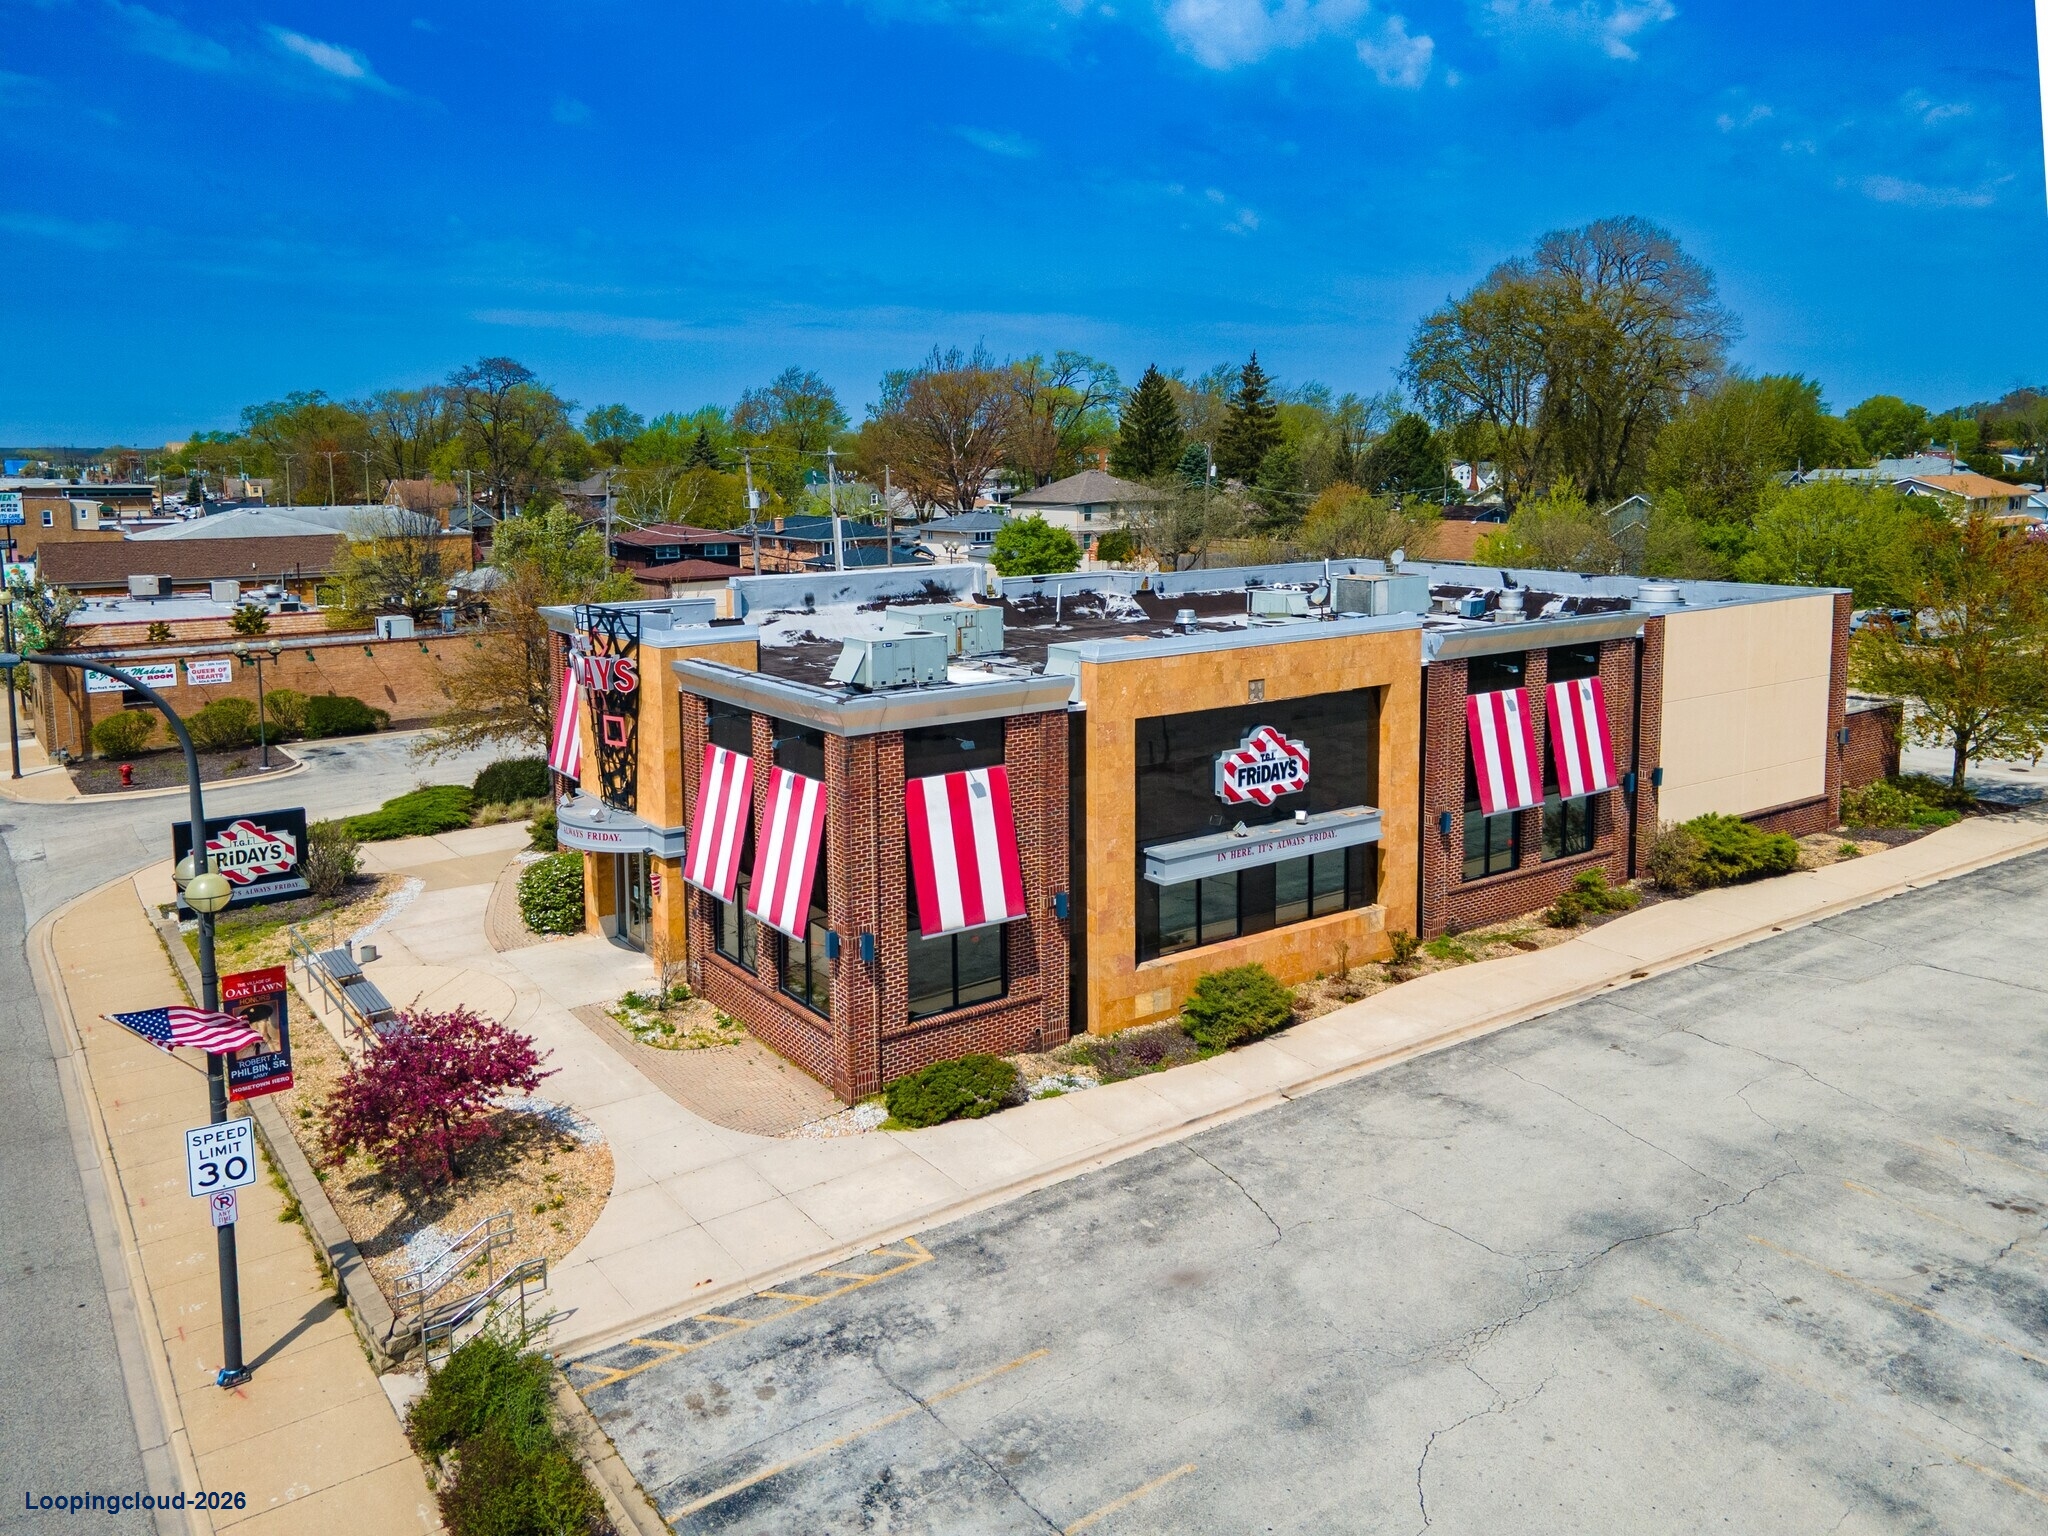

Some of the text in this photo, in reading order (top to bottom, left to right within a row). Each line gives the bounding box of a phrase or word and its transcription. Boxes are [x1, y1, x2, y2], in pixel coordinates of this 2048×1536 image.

[587, 831, 622, 842] FRIDAY.
[1217, 852, 1227, 862] IN
[1258, 842, 1273, 854] IT'S
[1277, 836, 1305, 849] ALWAYS
[1309, 830, 1337, 843] FRIDAY.
[246, 886, 271, 895] ALWAYS
[247, 978, 265, 986] VILLAGE
[225, 981, 283, 998] OAK LAWN
[240, 993, 271, 1006] HONORS
[231, 1059, 289, 1079] PHILBIN, SR.
[237, 1055, 271, 1069] ROBERT
[252, 1071, 269, 1080] ARMY
[232, 1076, 290, 1094] HOMETOWN HERO
[192, 1126, 247, 1147] SPEED
[199, 1141, 242, 1160] LIMIT
[198, 1156, 248, 1187] 30
[218, 1209, 231, 1217] ANY
[218, 1215, 232, 1224] TIME
